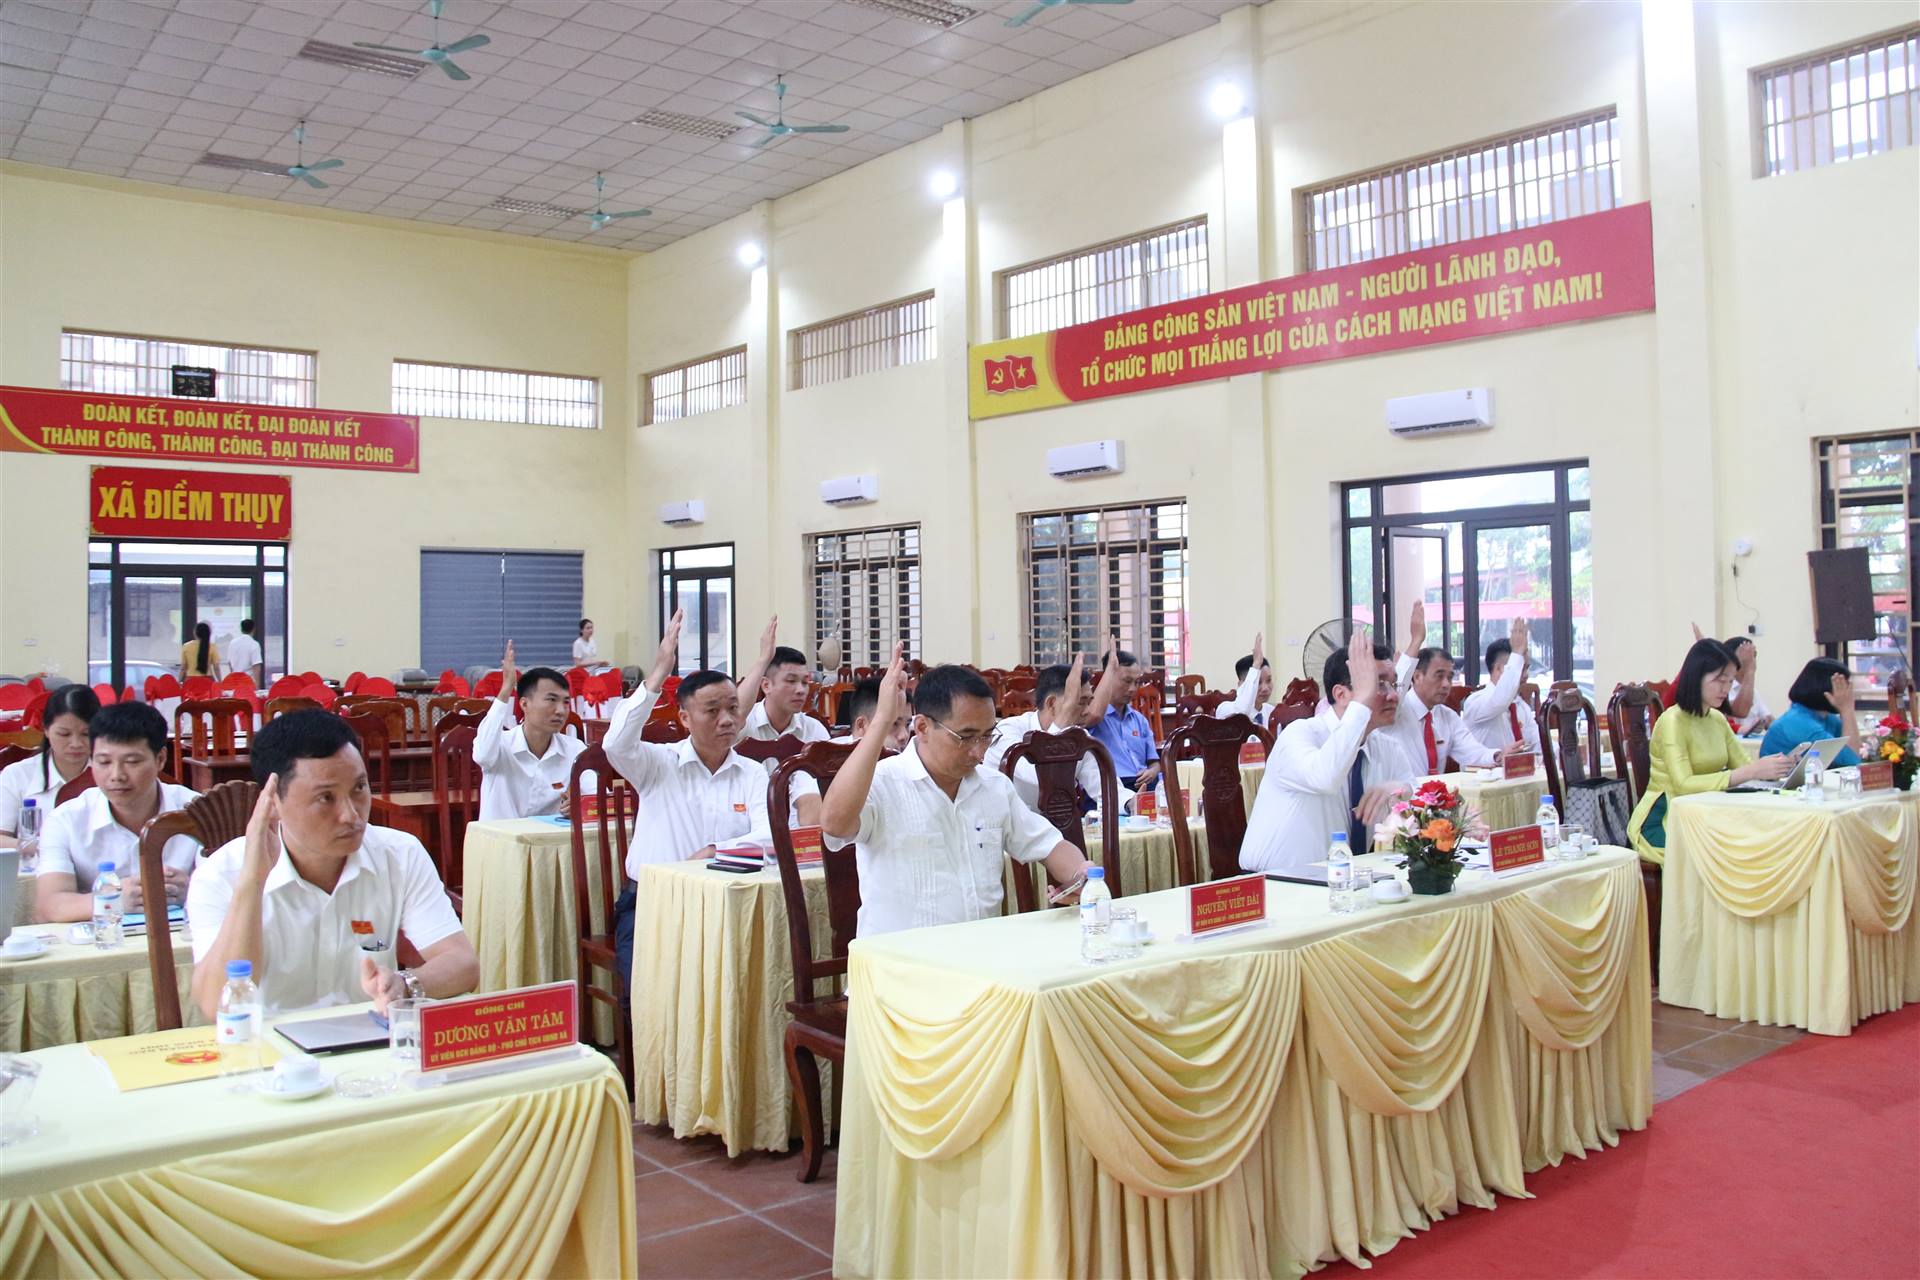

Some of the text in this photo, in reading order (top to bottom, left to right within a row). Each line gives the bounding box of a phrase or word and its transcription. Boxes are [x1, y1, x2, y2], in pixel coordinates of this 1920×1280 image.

[1104, 321, 1147, 350] ĐẢNG
[1153, 312, 1199, 342] CỘNG
[1205, 299, 1242, 330] SẢN
[1247, 292, 1286, 323] VIỆT
[1293, 283, 1339, 313] NAM
[1360, 263, 1427, 301] NGƯỜI
[1435, 252, 1496, 287] LÃNH
[1504, 240, 1561, 275] ĐẠO,
[1081, 272, 1602, 387] TỔ CHỨC MỌI THẮNG LỢI CỦA CÁCH MẠNG VIỆT NAM!
[84, 402, 361, 437] ĐOÀN KẾT, ĐOÀN KẾT, ĐẠI ĐOÀN KẾT
[42, 426, 393, 463] THÀNH CÔNG, THÀNH CÔNG, ĐẠI THÀNH CÔNG
[99, 480, 284, 529] XÃ ĐIỀM THỤY
[434, 1009, 564, 1047] DƯƠNG VĂN TÁM
